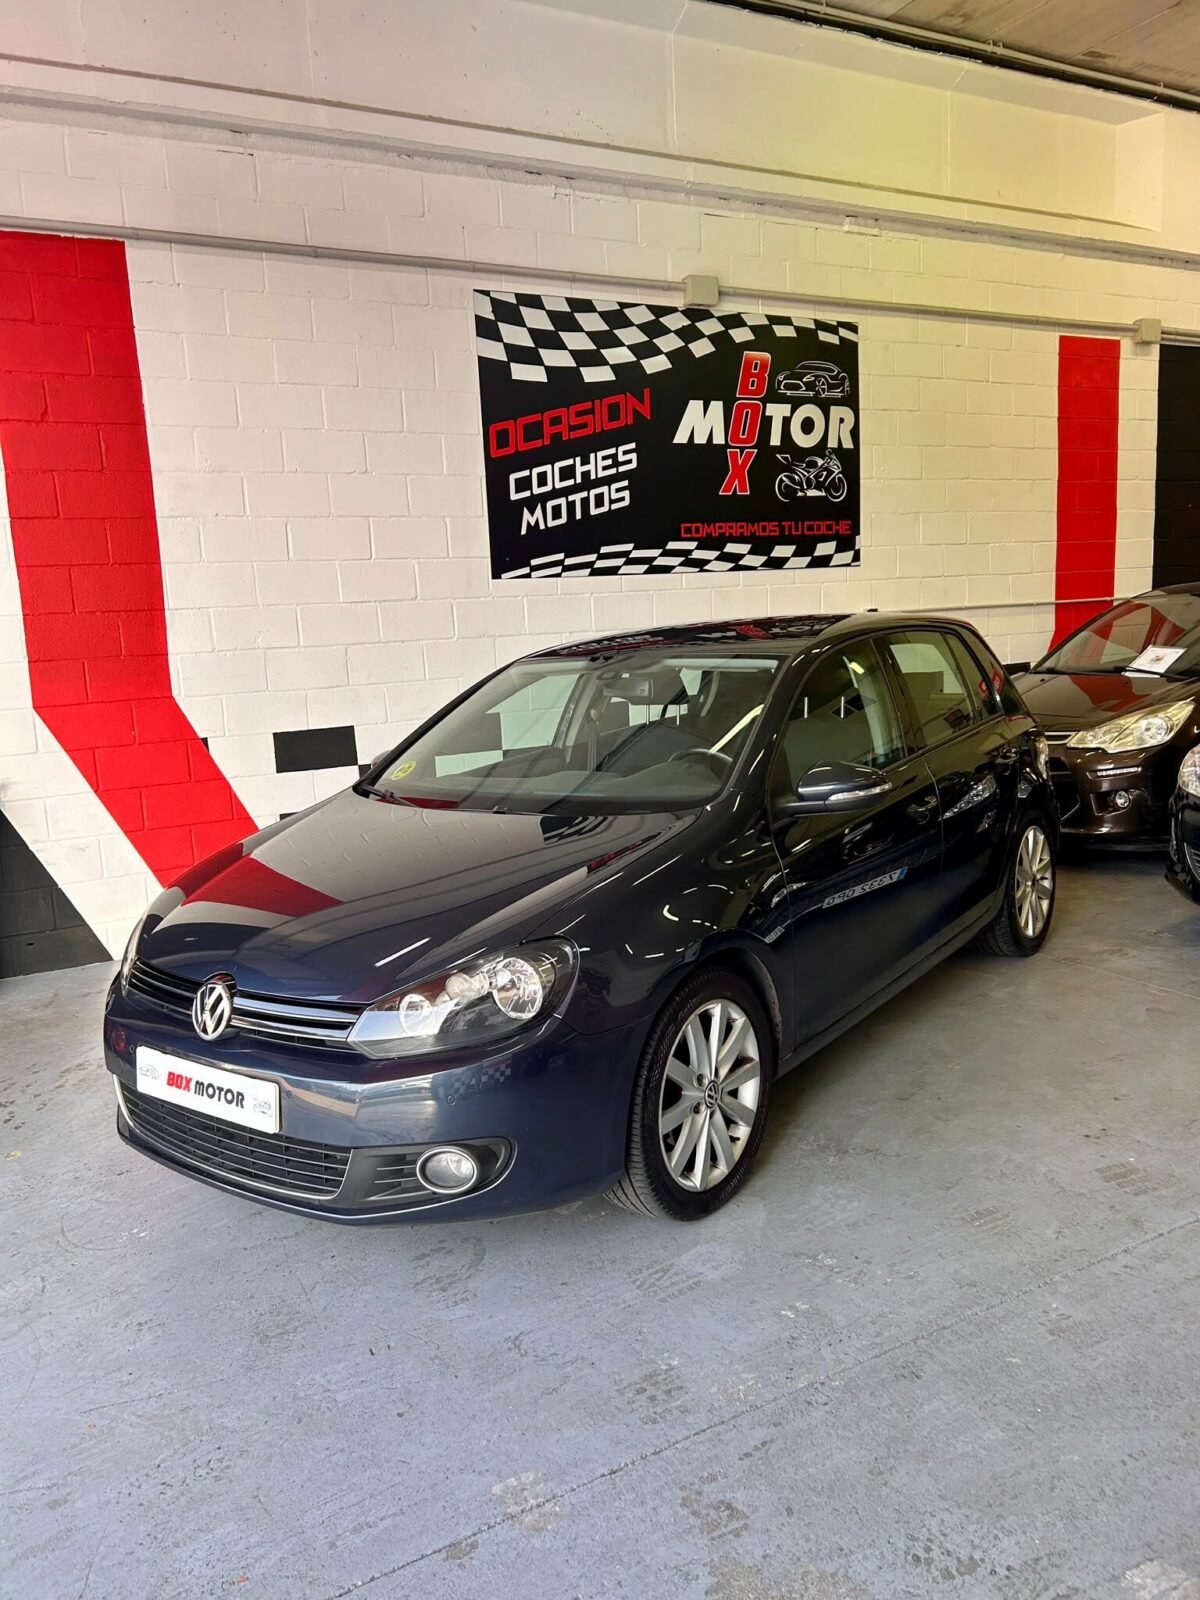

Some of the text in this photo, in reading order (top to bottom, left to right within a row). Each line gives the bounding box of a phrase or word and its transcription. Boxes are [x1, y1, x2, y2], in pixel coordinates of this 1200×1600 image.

[489, 387, 651, 458] OCASION
[672, 399, 855, 449] MOTOR
[719, 351, 772, 496] BOX
[509, 442, 638, 501] COCHES
[520, 480, 631, 535] MOTOS
[681, 520, 852, 538] COMPRAMOS TU COCHE
[166, 1071, 245, 1109] BOX MOTOR
